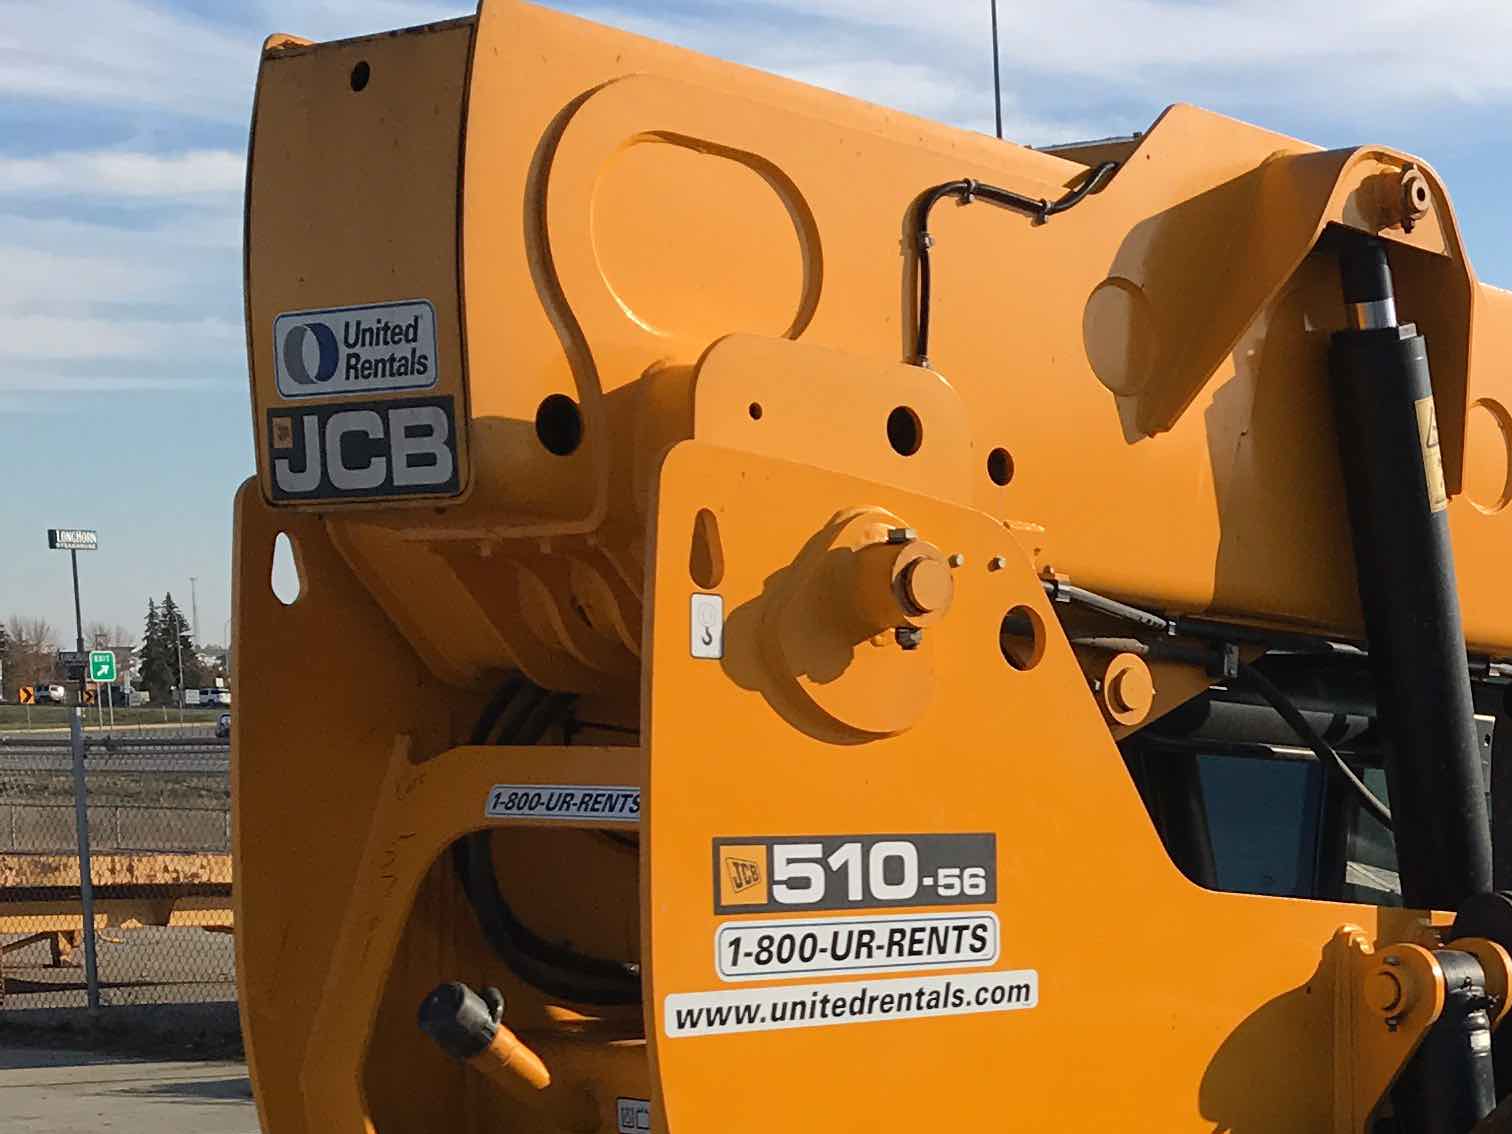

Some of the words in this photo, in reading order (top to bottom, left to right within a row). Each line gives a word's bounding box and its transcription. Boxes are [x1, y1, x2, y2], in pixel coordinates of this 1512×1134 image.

[343, 314, 420, 349] United
[344, 348, 429, 381] Rentals
[274, 405, 453, 493] JCB
[491, 791, 640, 813] 1-800-UR-RENTS
[730, 861, 760, 889] JCB
[726, 922, 989, 968] 1-800-UR-RENTS
[675, 981, 1032, 1030] www.unitedrentals.com
